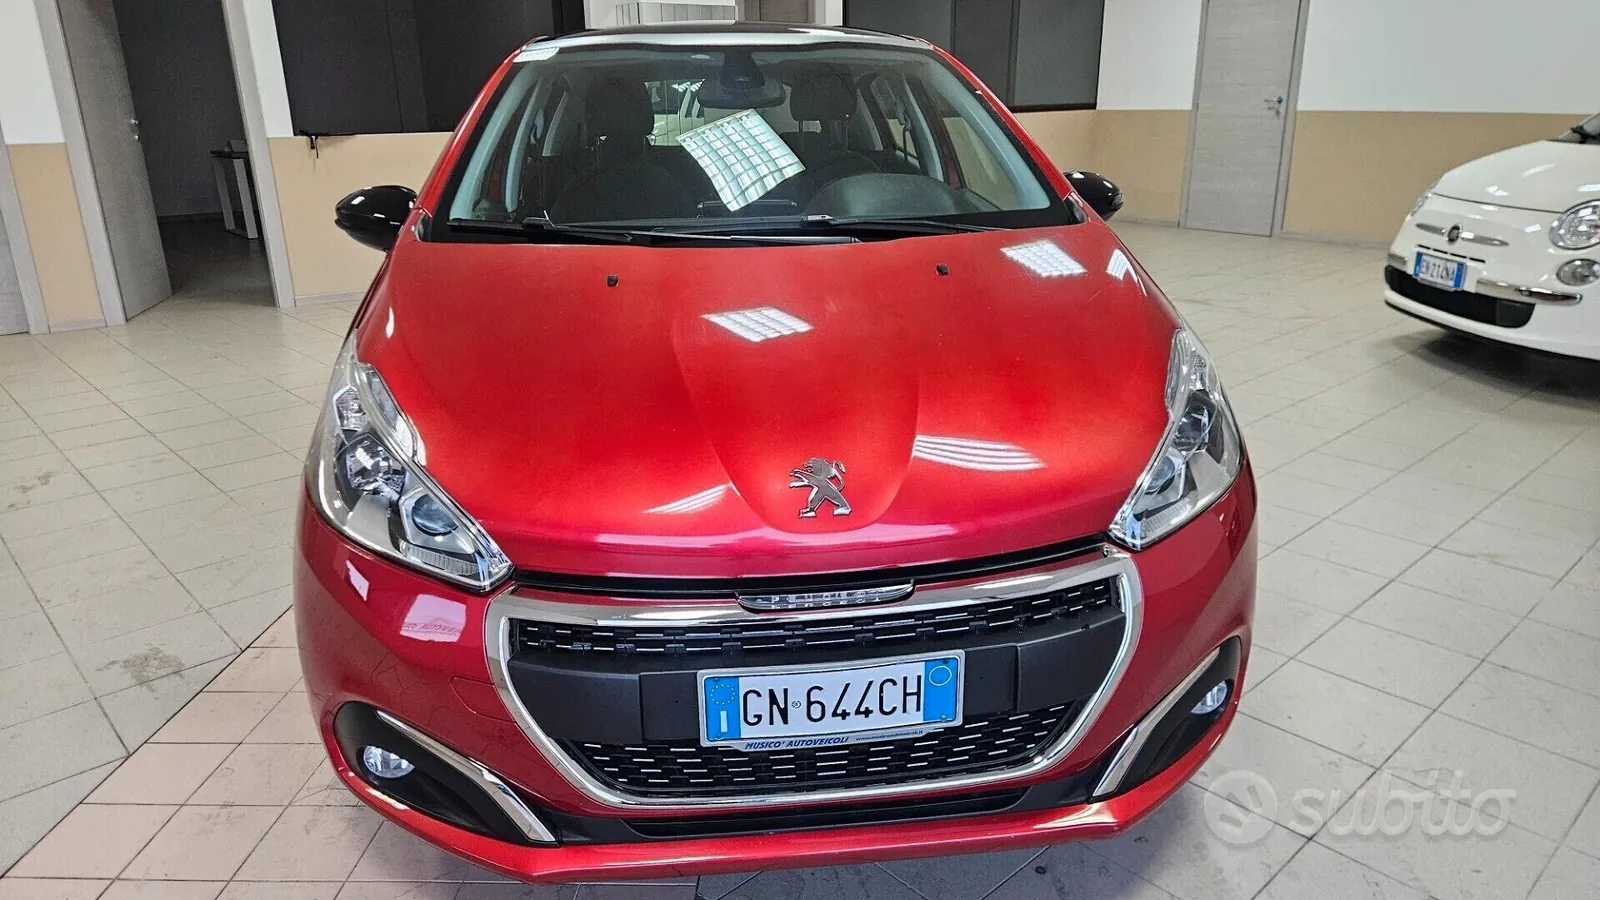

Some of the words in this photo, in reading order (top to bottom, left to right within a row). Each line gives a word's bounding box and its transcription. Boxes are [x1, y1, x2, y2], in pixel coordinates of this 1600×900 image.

[742, 687, 789, 726] GN
[806, 674, 922, 723] 644CH
[786, 736, 850, 748] AUTOVEICOLI
